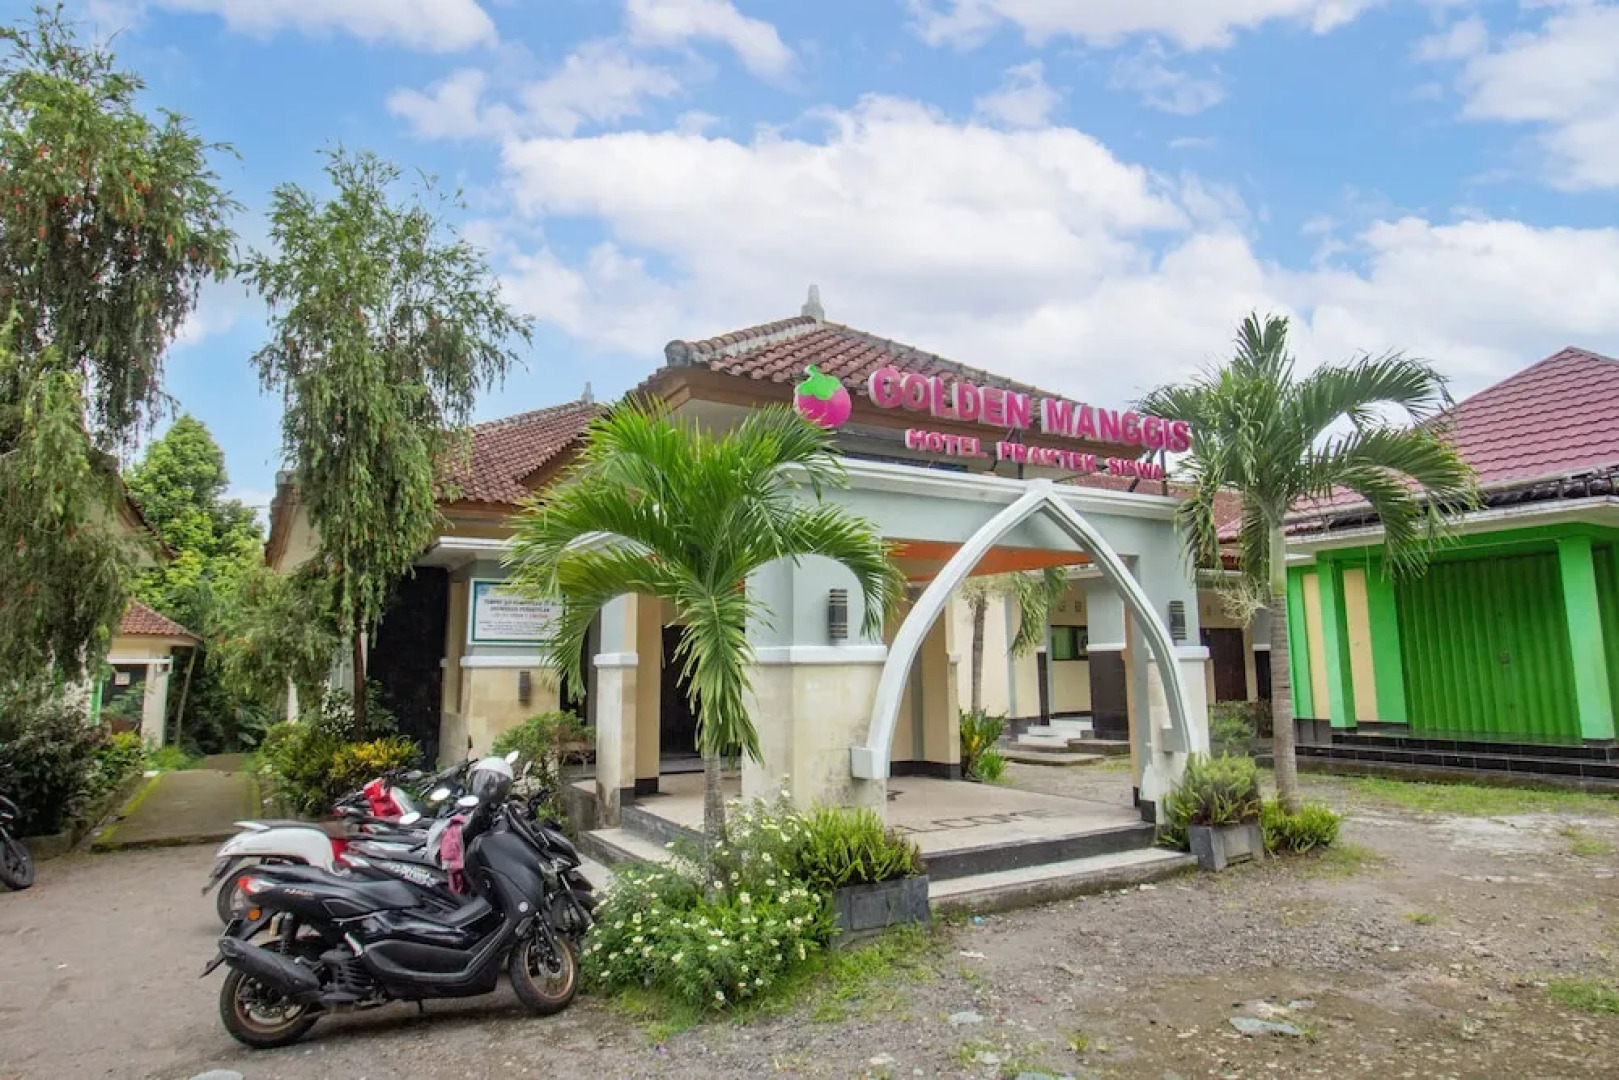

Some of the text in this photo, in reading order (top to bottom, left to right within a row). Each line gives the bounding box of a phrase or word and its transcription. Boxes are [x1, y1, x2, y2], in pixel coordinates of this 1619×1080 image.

[868, 366, 1192, 453] GOLDEN MANGGIS
[905, 428, 1166, 481] HOTEL PRAKTEK SISWA
